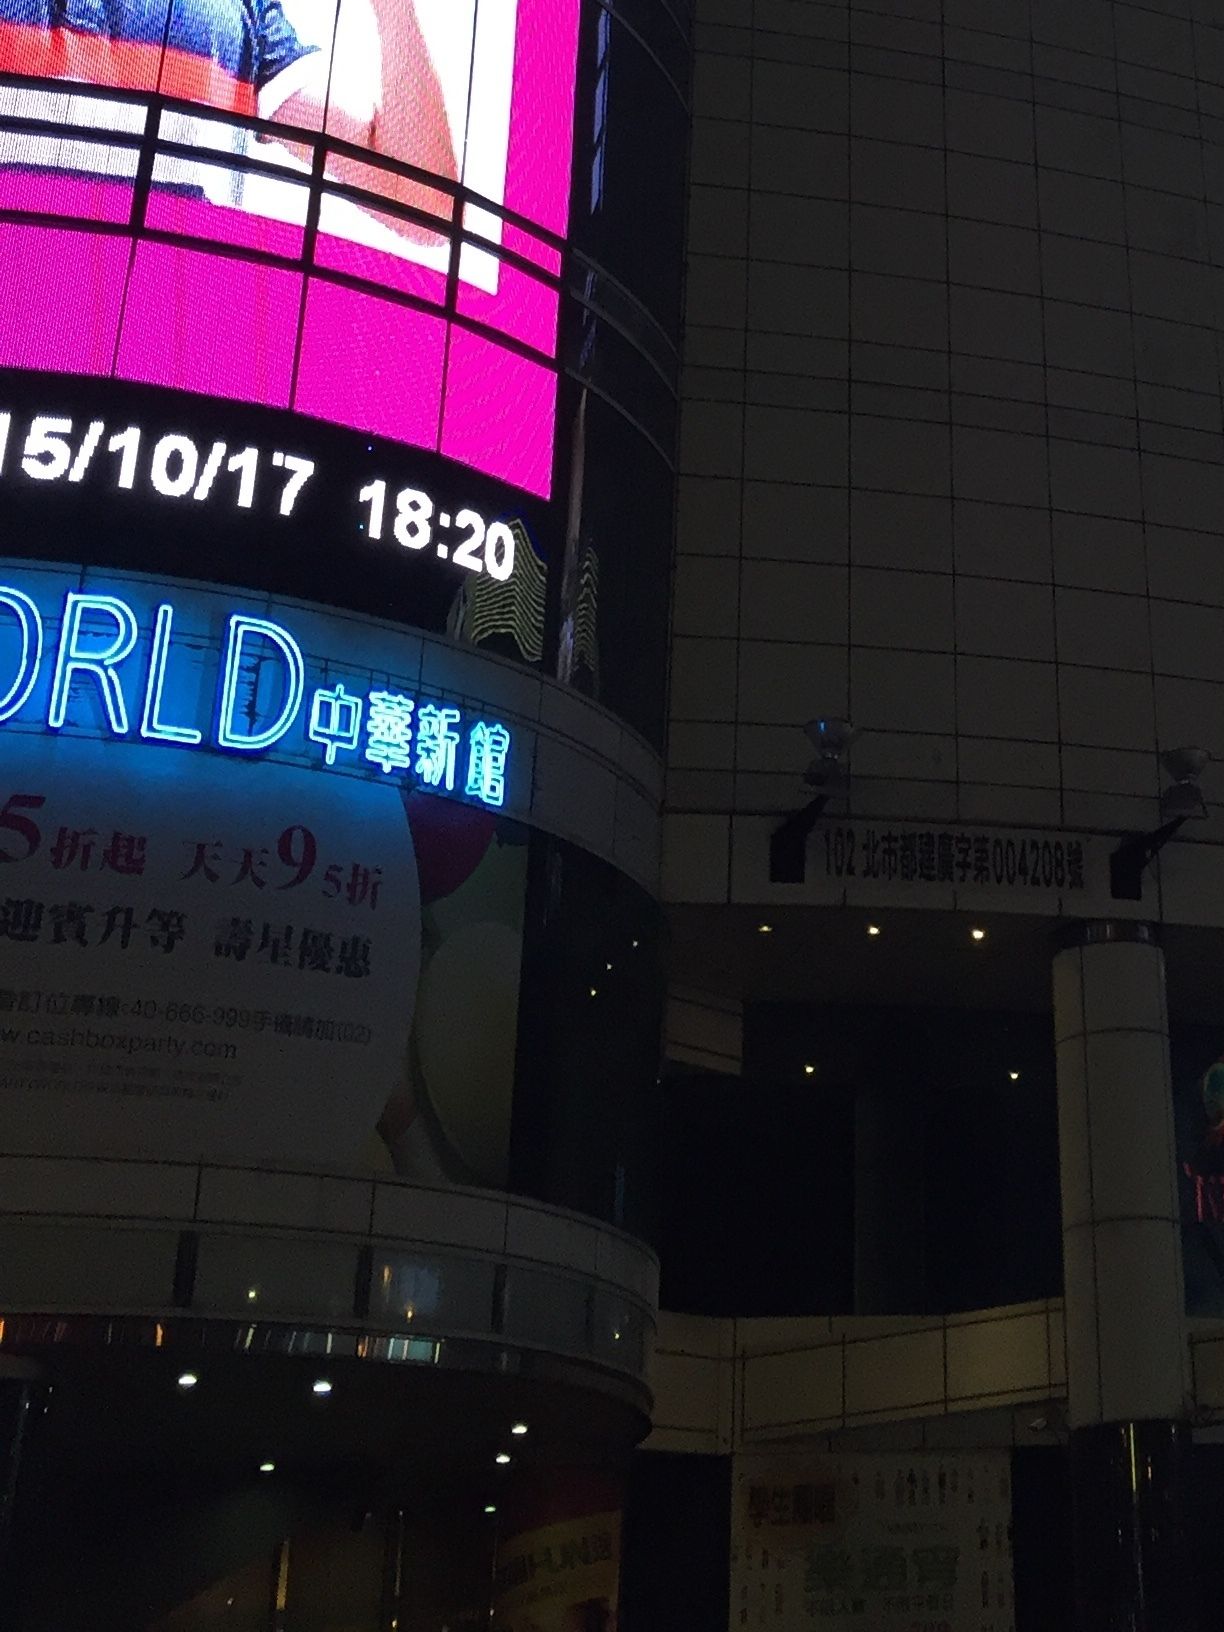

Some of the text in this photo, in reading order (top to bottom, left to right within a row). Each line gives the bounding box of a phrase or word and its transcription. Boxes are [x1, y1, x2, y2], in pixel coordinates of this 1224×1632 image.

[358, 479, 516, 582] 18:20
[308, 683, 511, 807] 中華新館
